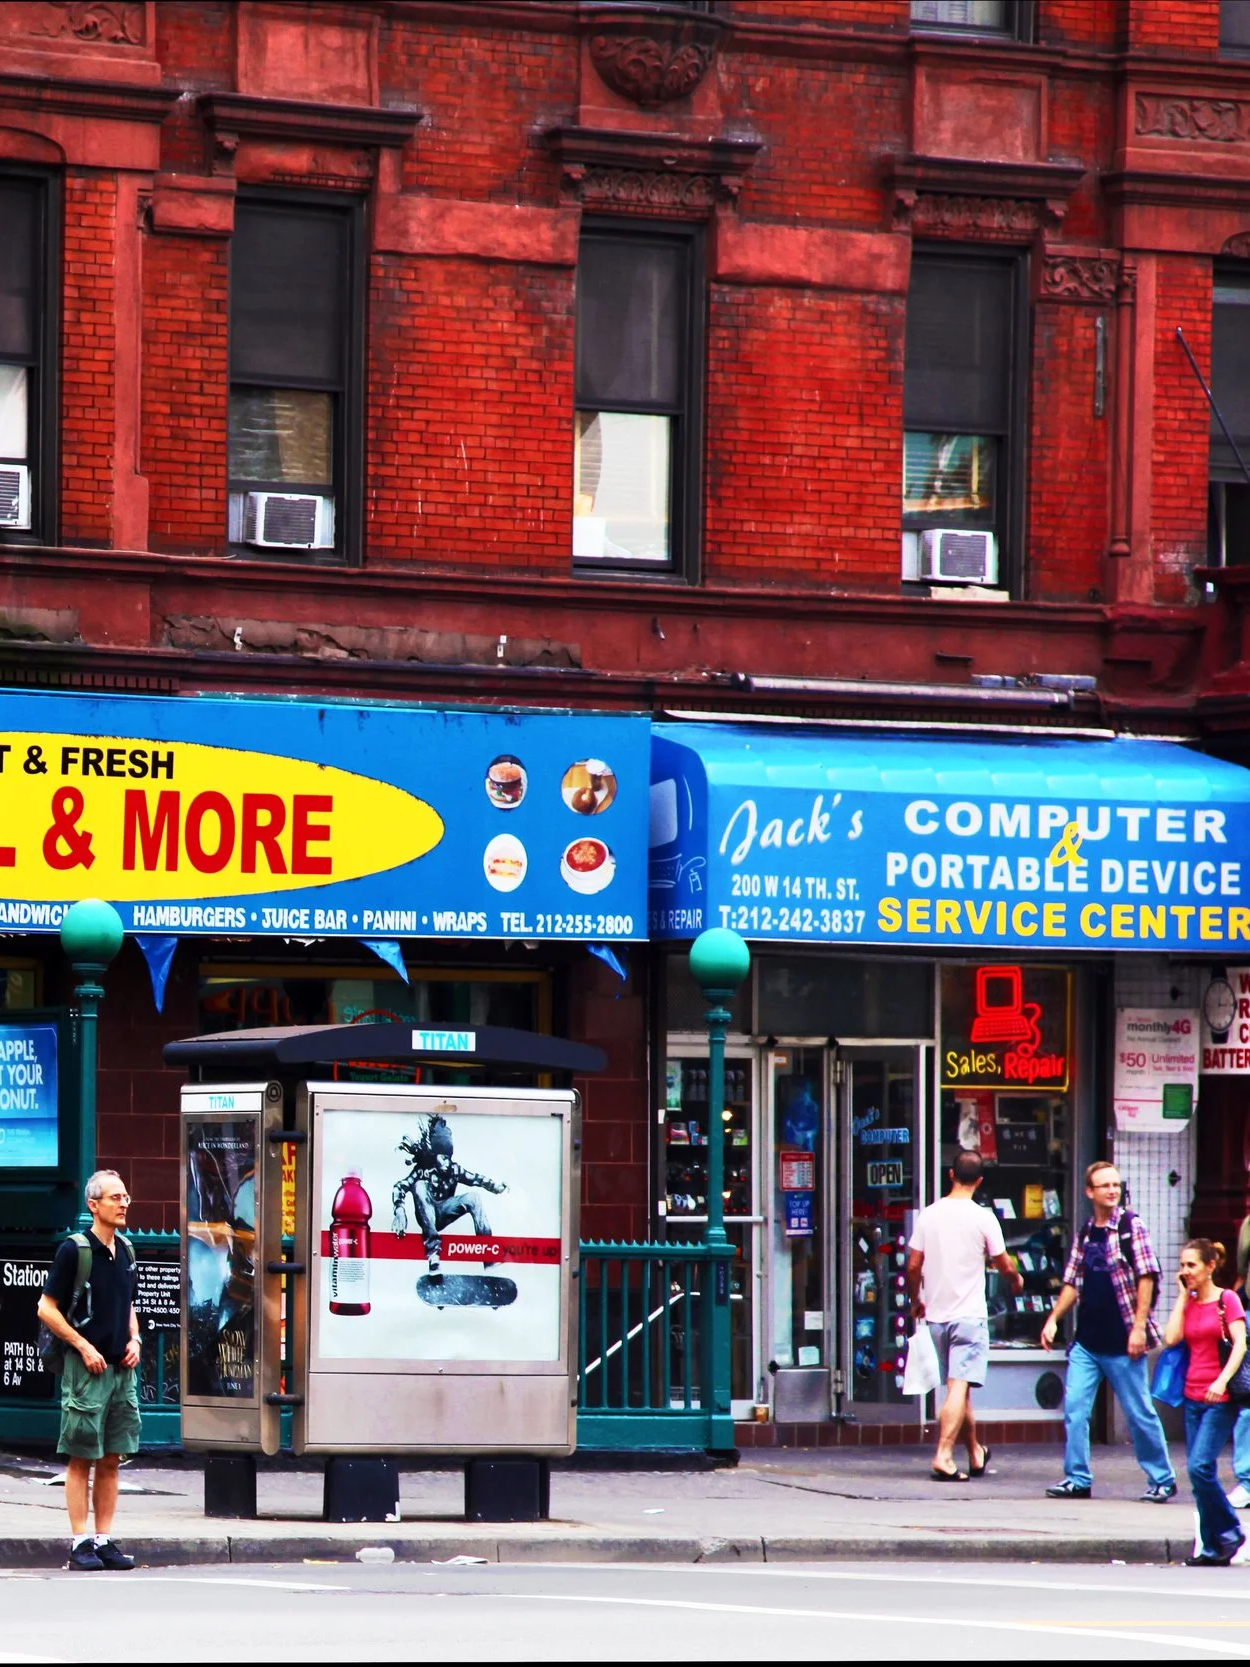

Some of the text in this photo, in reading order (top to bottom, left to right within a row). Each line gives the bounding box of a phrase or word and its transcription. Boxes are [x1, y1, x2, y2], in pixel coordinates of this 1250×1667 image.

[23, 745, 48, 776] &
[61, 747, 174, 780] FRESH
[42, 785, 96, 871] &
[122, 788, 333, 876] MORE
[719, 792, 863, 867] Jack's
[904, 799, 1228, 844] COMPUTER
[1049, 821, 1084, 868] &
[886, 851, 1241, 896] PORTABLE DEVICE
[731, 874, 859, 901] 200 W 14 TH. ST.
[133, 904, 246, 928] HAMBURGERS
[262, 907, 310, 930] JUICE
[314, 908, 347, 930] BAR
[363, 909, 416, 932] PANINI
[433, 911, 487, 932] WRAPS
[500, 911, 533, 934] TEL.
[536, 913, 633, 935] 212-255-2800
[668, 908, 703, 930] REPAIR
[719, 905, 866, 934] T:212-242-3837
[877, 896, 1250, 941] SERVICE CENTER
[419, 1032, 468, 1051] TITAN
[946, 1048, 1066, 1084] Sales, Repair
[1119, 1052, 1146, 1068] $50
[1151, 1054, 1195, 1064] Unlimited
[6, 1063, 43, 1086] YOUR
[209, 1096, 234, 1109] TITAN
[861, 1127, 910, 1145] COMPUTER
[870, 1163, 901, 1186] OPEN
[448, 1242, 499, 1256] power-c
[3, 1262, 48, 1287] Station
[159, 1266, 181, 1275] property
[138, 1289, 159, 1298] Property
[157, 1282, 181, 1290] delivered
[4, 1342, 24, 1357] PATH
[26, 1343, 34, 1356] to
[4, 1357, 44, 1373] at 14 St &
[3, 1372, 22, 1386] 6 Av
